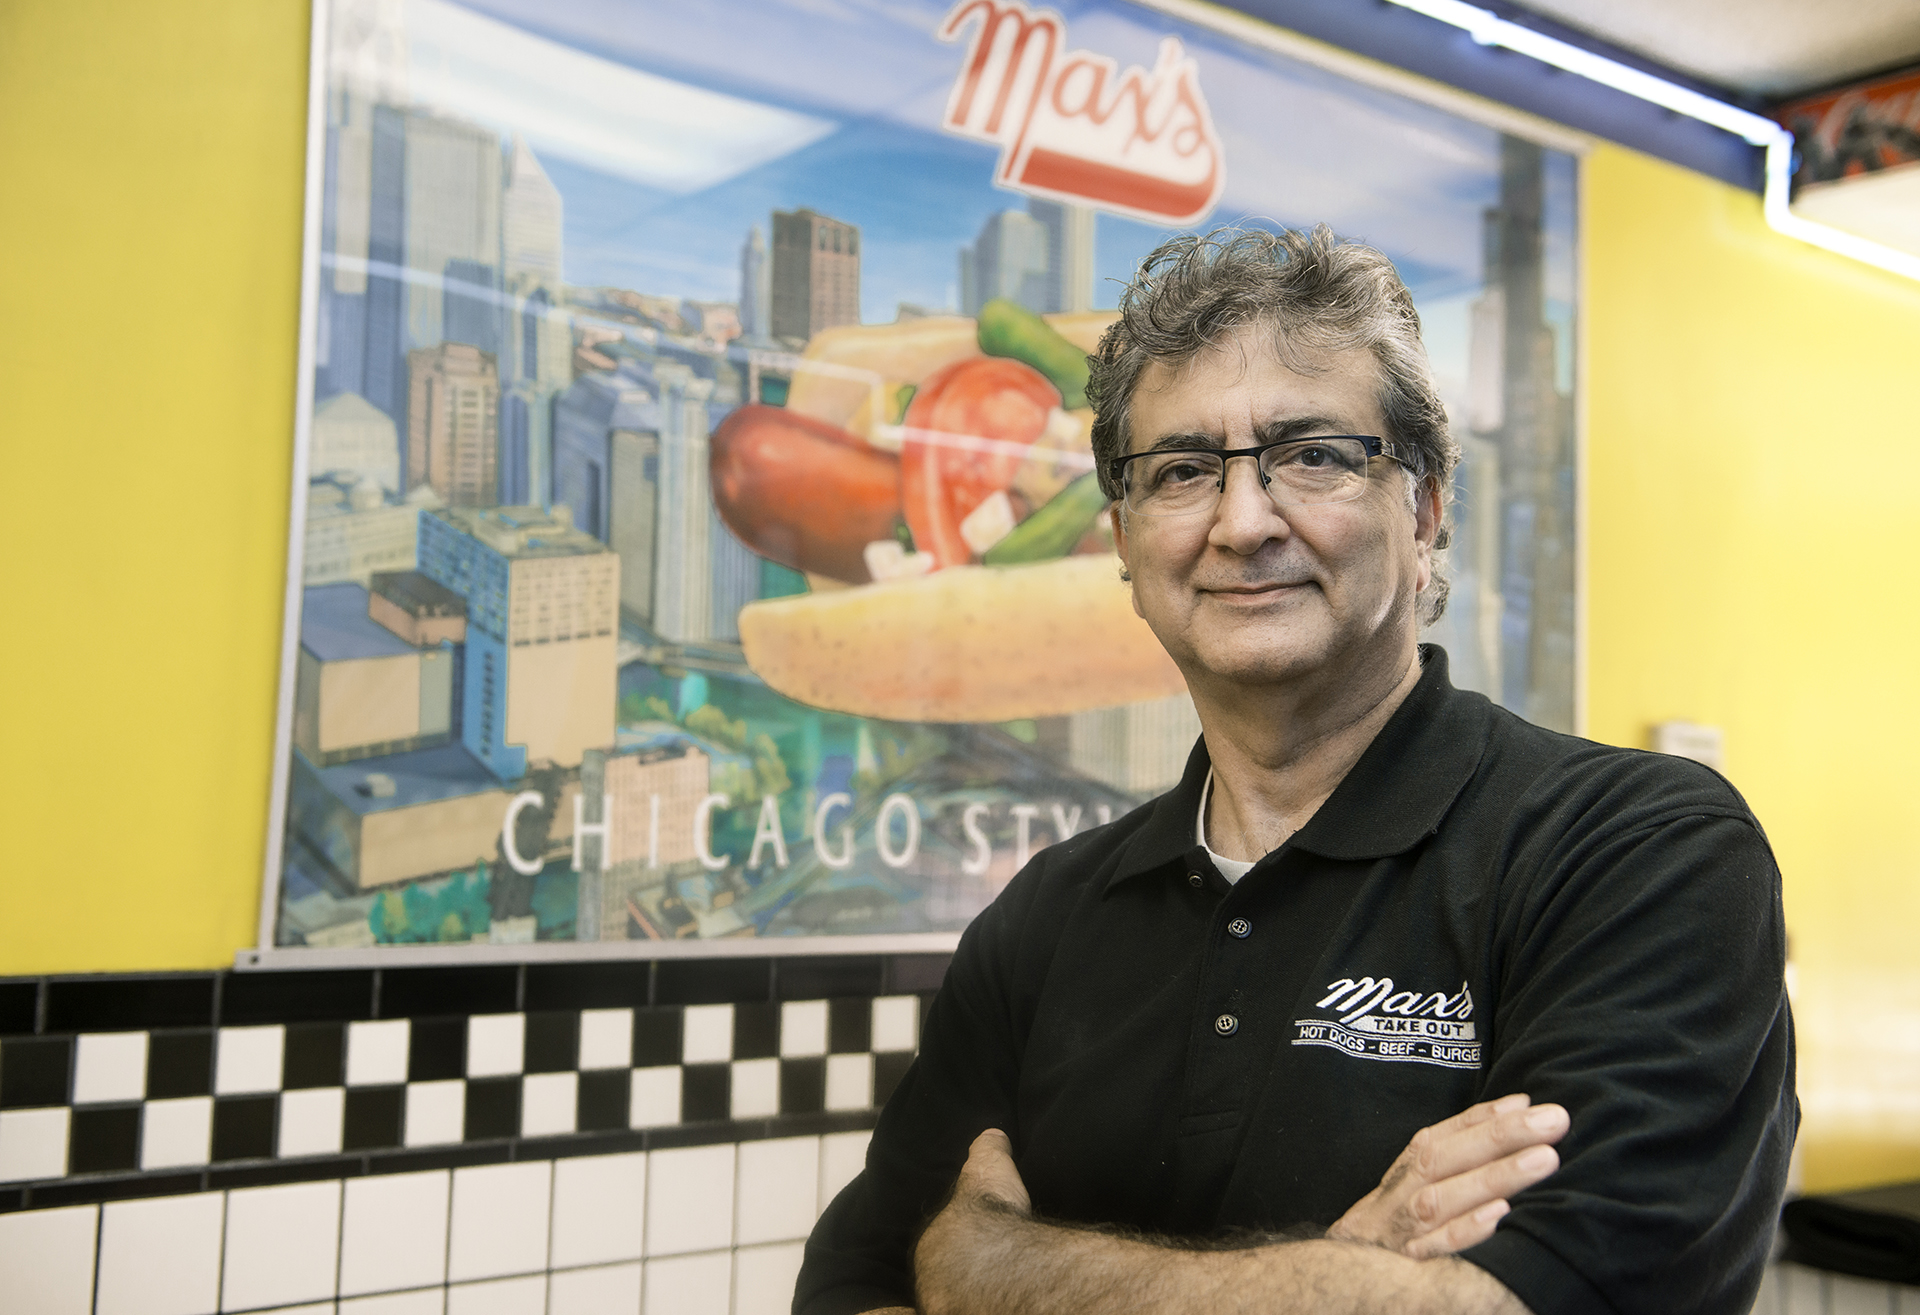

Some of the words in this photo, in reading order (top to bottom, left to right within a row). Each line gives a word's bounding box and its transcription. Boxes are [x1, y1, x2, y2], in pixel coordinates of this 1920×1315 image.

[502, 790, 921, 876] CHICAGO
[1299, 1026, 1327, 1039] HOT
[1328, 1028, 1366, 1052] DOGS
[1378, 1041, 1416, 1056] BEEF
[1373, 1018, 1420, 1034] TAKE
[1425, 1021, 1465, 1037] OUT
